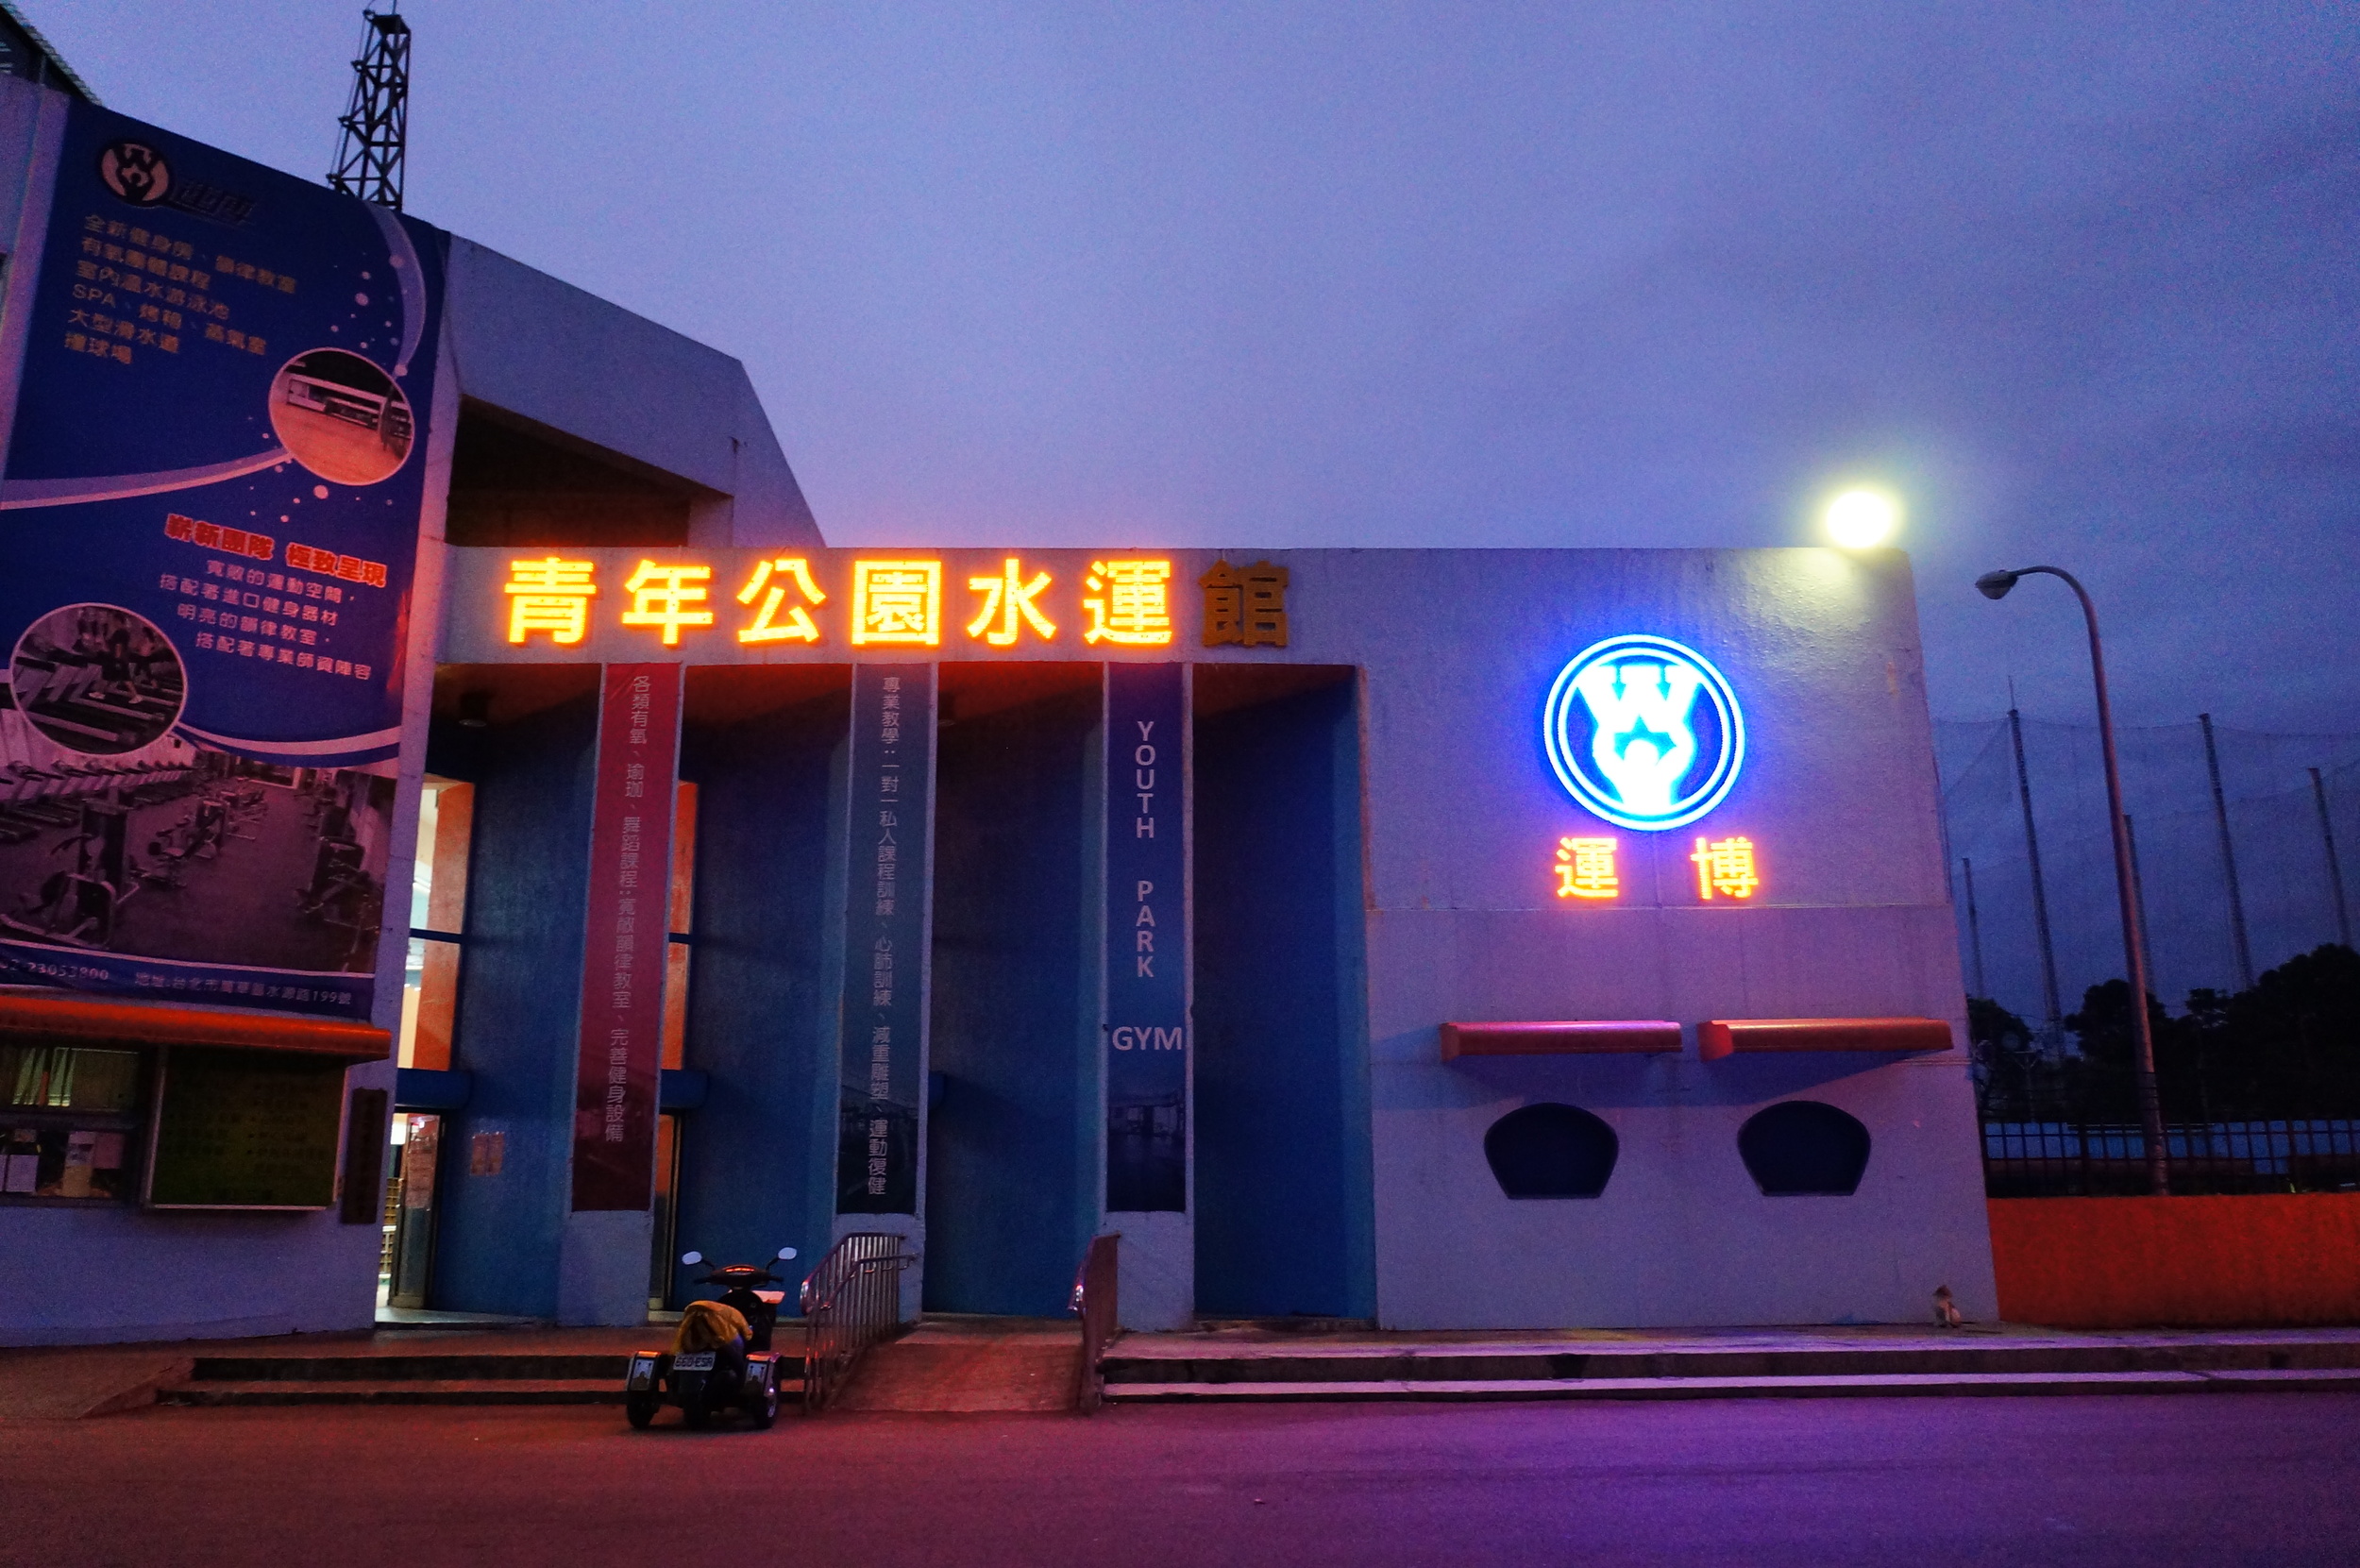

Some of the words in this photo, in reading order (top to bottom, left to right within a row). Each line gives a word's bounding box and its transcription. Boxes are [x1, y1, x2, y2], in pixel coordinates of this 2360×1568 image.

[164, 513, 275, 561] 嶄新團隊
[286, 542, 389, 588] 極致呈現
[160, 573, 338, 626] 搭配著進口健身器材
[503, 557, 1289, 649] 青年公園水運館
[1136, 720, 1156, 839] YOUTH
[1136, 880, 1155, 978] PARK
[1112, 1026, 1183, 1051] GYM
